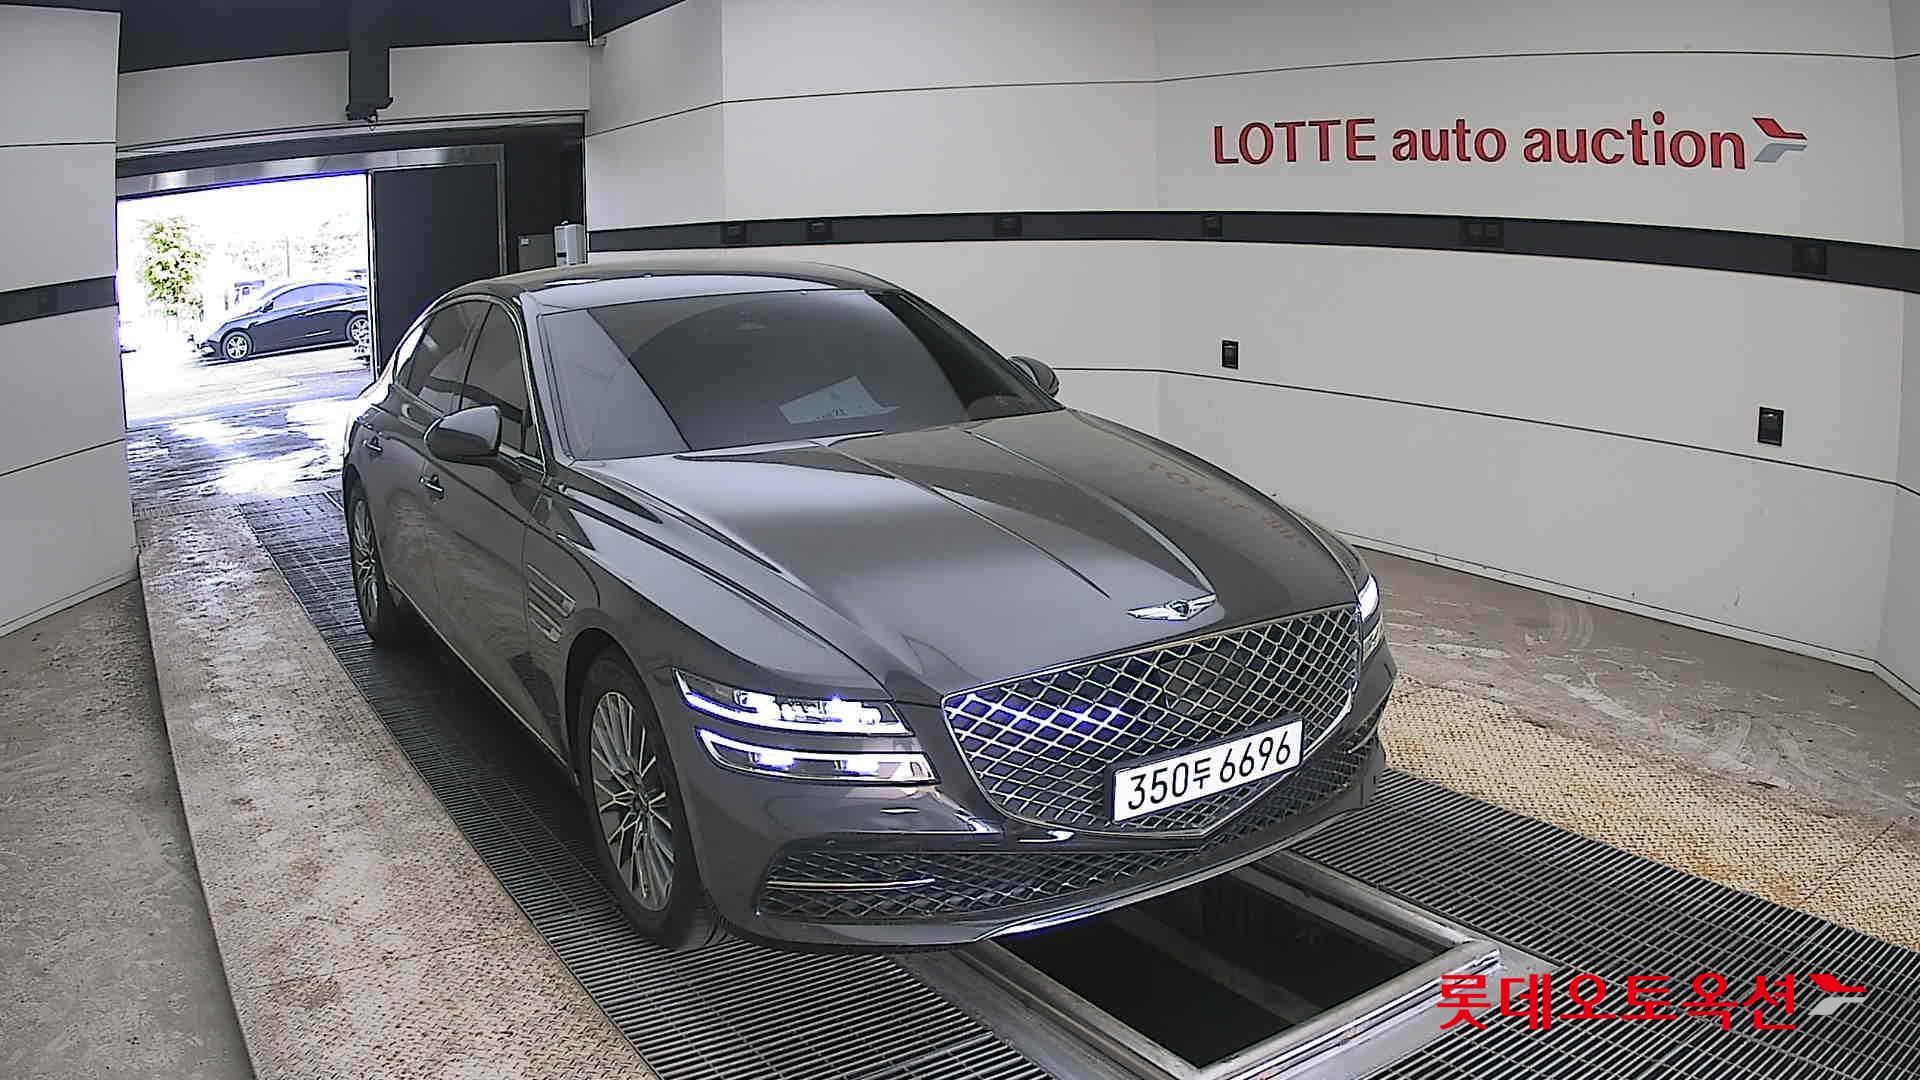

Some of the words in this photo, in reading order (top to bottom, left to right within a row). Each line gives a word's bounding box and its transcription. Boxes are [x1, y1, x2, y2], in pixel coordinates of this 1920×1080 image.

[1213, 117, 1376, 165] LOTTE
[1391, 118, 1507, 163] auto
[1523, 110, 1746, 170] auction
